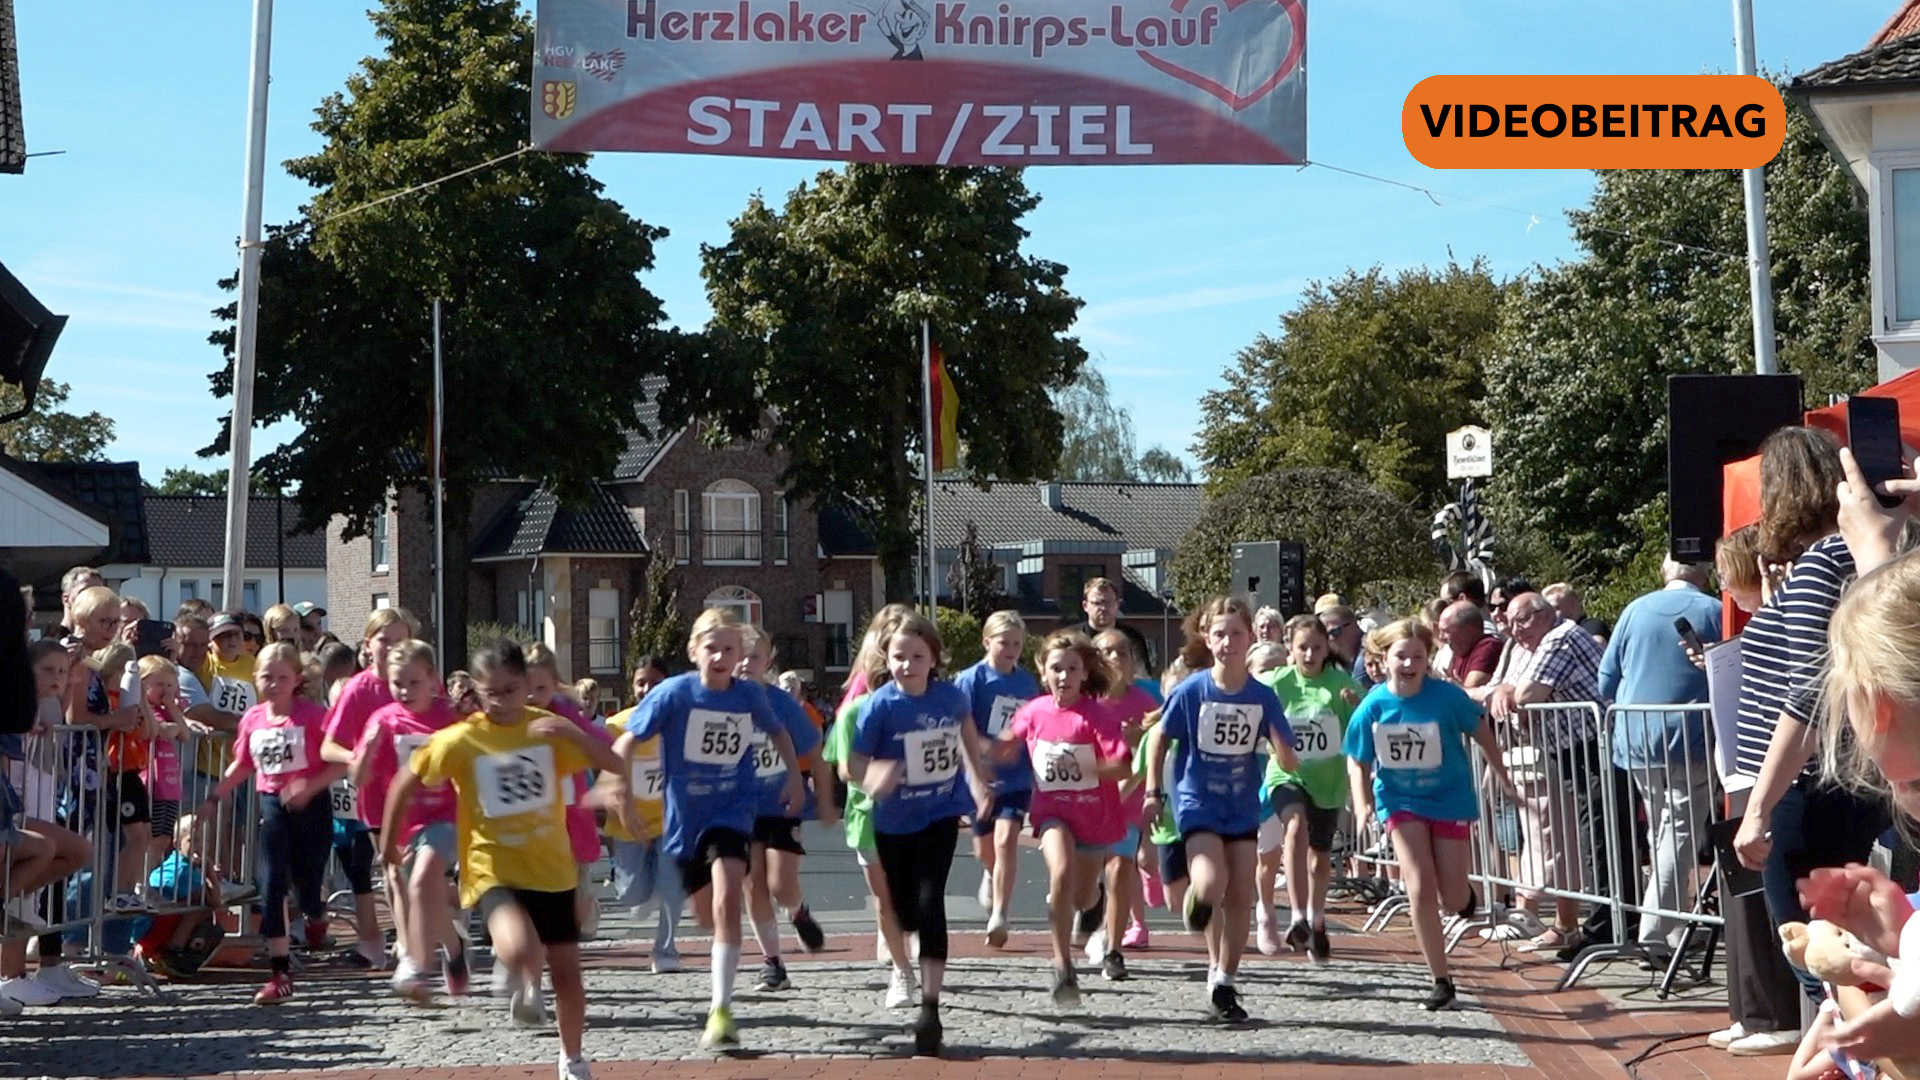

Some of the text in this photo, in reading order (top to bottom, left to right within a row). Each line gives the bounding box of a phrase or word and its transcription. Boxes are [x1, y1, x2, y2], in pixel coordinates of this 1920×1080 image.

[626, 0, 1221, 58] Herzlaker Knirps-Lauf
[686, 96, 1154, 165] START/ZIEL
[218, 691, 248, 712] 515
[701, 732, 741, 755] 553
[1214, 722, 1251, 746] 552
[1294, 731, 1328, 752] 570
[1390, 741, 1426, 762] 577
[1045, 761, 1082, 782] 563
[334, 793, 357, 812] 56
